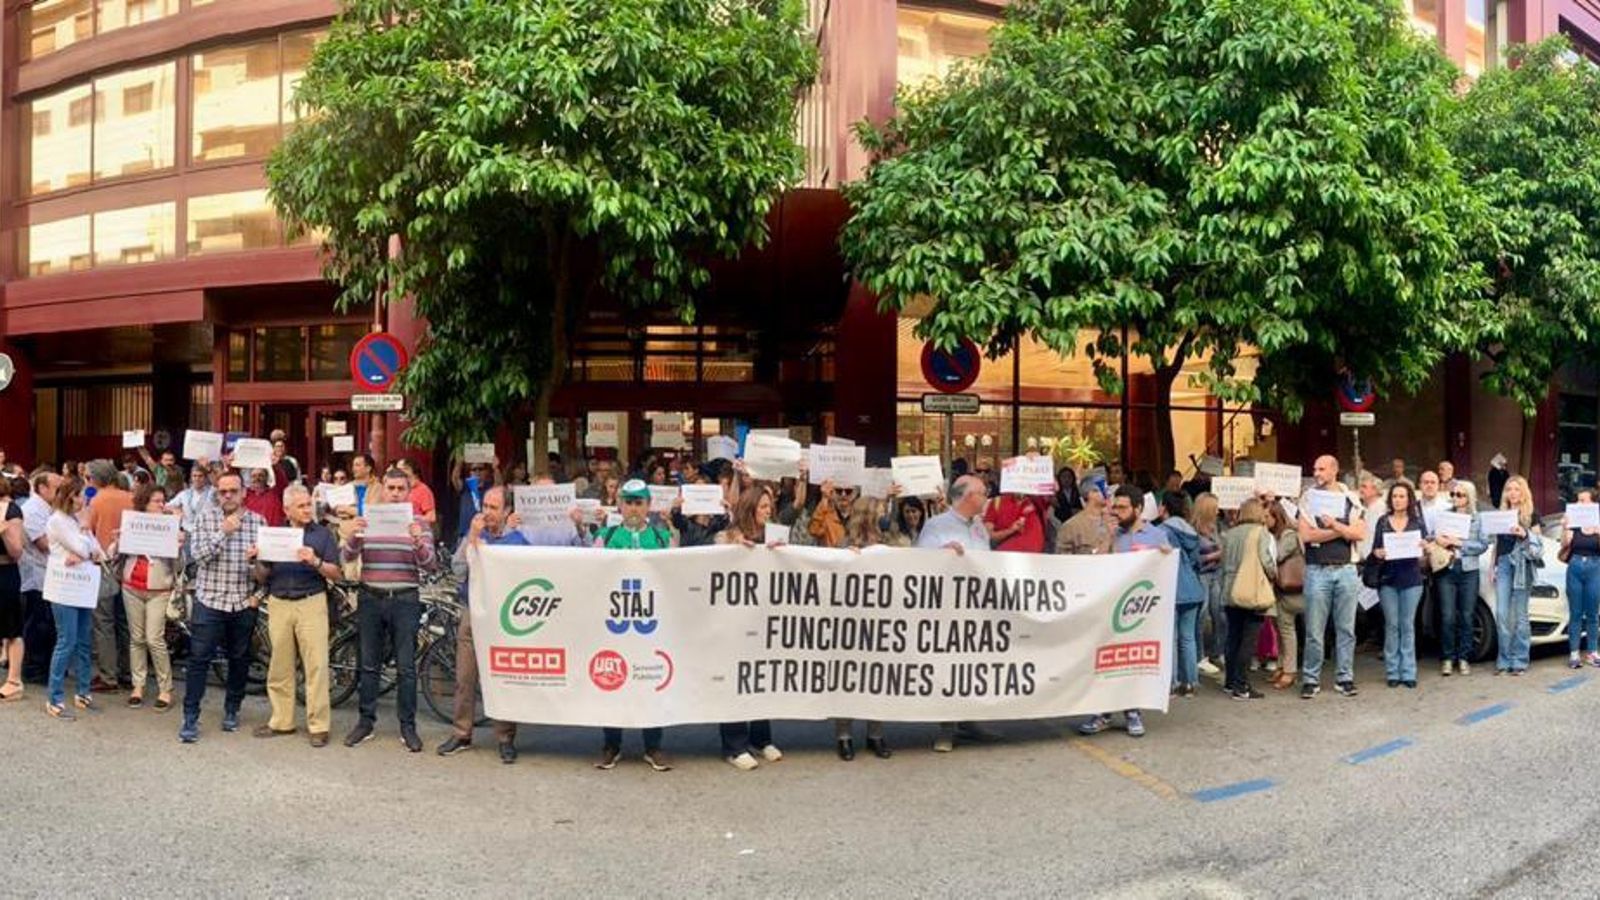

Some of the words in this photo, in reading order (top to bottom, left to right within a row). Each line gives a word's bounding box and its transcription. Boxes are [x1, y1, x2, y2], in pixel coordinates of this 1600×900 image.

[590, 422, 615, 433] SALIDA
[655, 423, 681, 433] SALIDA
[519, 494, 537, 505] YO
[540, 494, 572, 505] PARO
[145, 523, 171, 532] PARO
[710, 571, 759, 606] POR
[769, 571, 820, 606] UNA
[830, 572, 893, 609] LOEO
[903, 574, 944, 610] SIN
[952, 575, 1067, 612] TRAMPAS
[511, 595, 562, 617] CSIF
[609, 590, 655, 618] STAJ
[1122, 595, 1161, 616] CSIF
[766, 615, 907, 653] FUNCIONES
[917, 619, 1011, 654] CLARAS
[494, 651, 562, 670] CCOO
[594, 656, 622, 675] UGT
[1098, 645, 1158, 666] CCOO
[737, 659, 934, 697] RETRIBUCIONES
[942, 662, 1036, 697] JUSTAS
